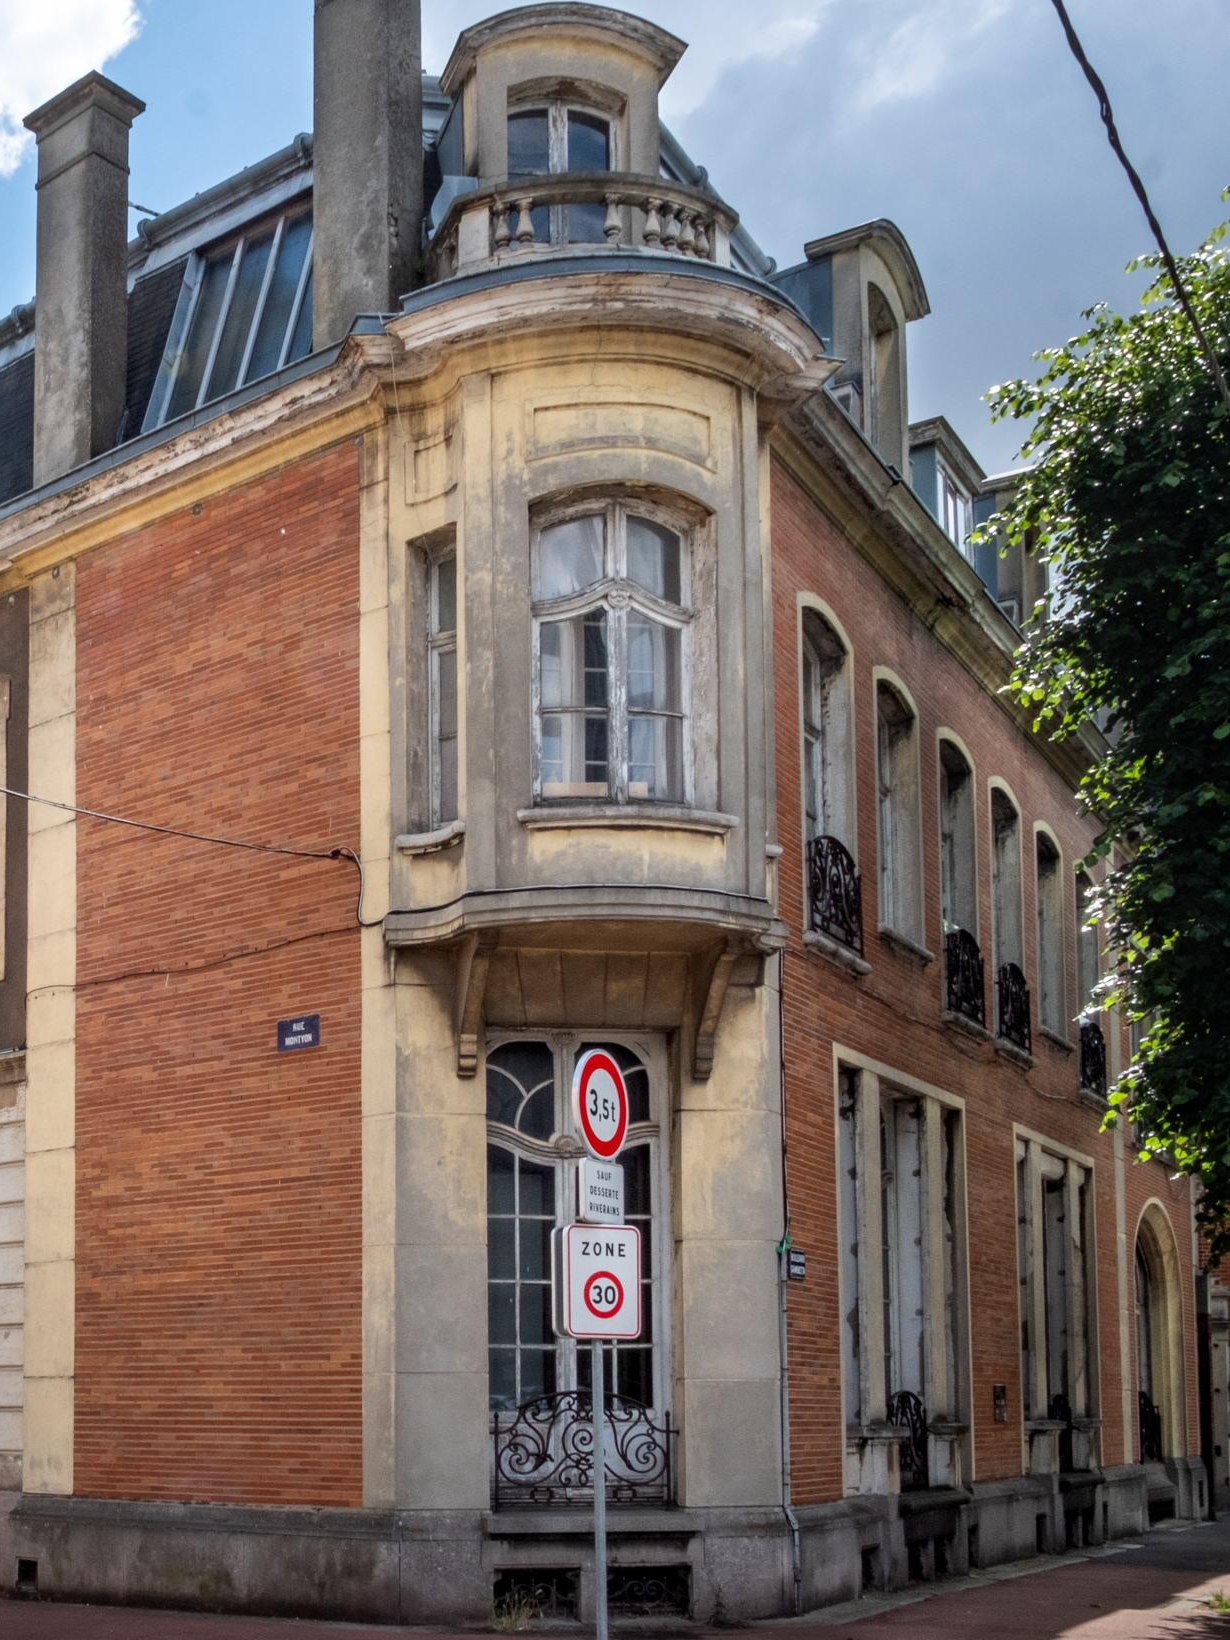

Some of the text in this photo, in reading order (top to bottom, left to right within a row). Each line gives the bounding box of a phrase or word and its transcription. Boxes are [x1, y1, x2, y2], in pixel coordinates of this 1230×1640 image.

[293, 1021, 305, 1032] RUE
[285, 1033, 312, 1046] MONTYON
[596, 1169, 612, 1182] SAUF
[589, 1185, 619, 1200] DESSERTE
[589, 1201, 620, 1217] RIVERAINS
[581, 1241, 627, 1258] ZONE
[592, 1284, 616, 1305] 30
